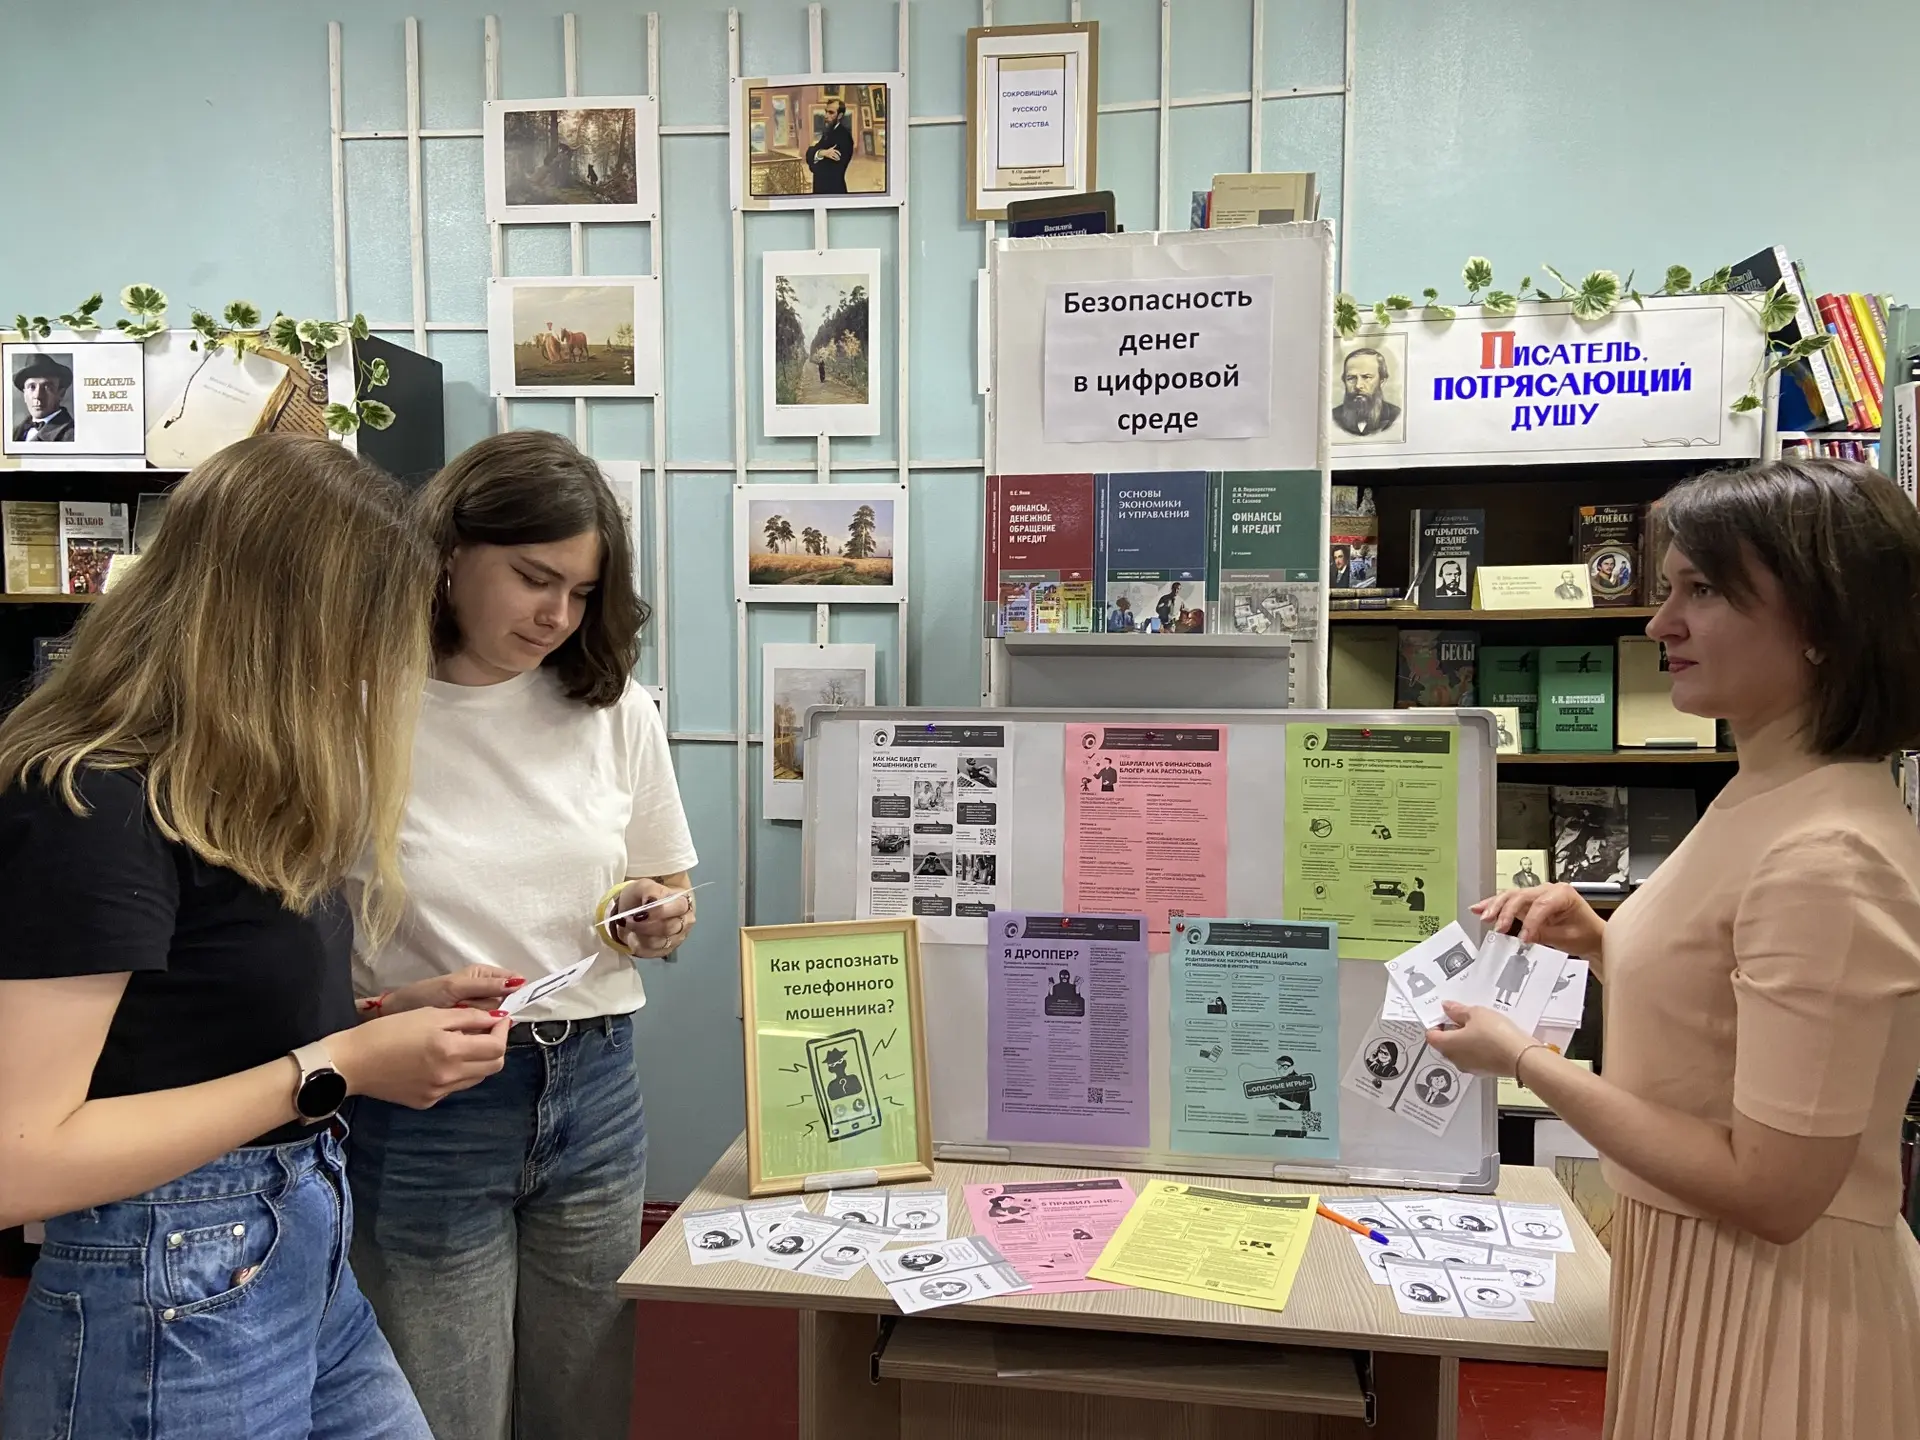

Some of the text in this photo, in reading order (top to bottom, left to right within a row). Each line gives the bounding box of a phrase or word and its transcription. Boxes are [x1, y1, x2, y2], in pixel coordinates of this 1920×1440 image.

[1002, 89, 1058, 98] СОКРОВИЩНИЦА
[1012, 105, 1048, 113] РУССКОГО
[1009, 121, 1050, 129] ИСКУССТВА
[1063, 290, 1253, 314] Безопасность
[1118, 332, 1200, 357] денег
[83, 377, 136, 387] ПИСАТЕЛЬ
[1073, 363, 1239, 396] в цифровой
[1433, 361, 1692, 401] ПОТРЯСАЮЩИЙ
[92, 390, 128, 399] НА ВСЕ
[86, 402, 135, 412] ВРЕМЕНА
[1117, 410, 1199, 435] среде
[1510, 403, 1600, 432] ДУШУ
[1905, 413, 1913, 492] ЛИТЕРАТУРА
[1118, 490, 1162, 499] ОСНОВЫ
[1009, 503, 1051, 513] ФИНАНСЫ,
[1118, 500, 1182, 509] ЭКОНОМИКИ
[1009, 513, 1053, 524] ДЕНЕЖНОЕ
[1118, 510, 1190, 519] И УПРАВЛЕНИЯ
[1231, 511, 1283, 522] ФИНАНСЫ
[1009, 524, 1056, 533] ОБРАЩЕНИЕ
[1231, 524, 1282, 535] И КРЕДИТ
[1009, 534, 1048, 544] И КРЕДИТ
[1435, 536, 1468, 545] БЕЗДНЕ
[1440, 643, 1476, 661] БЕСЫ
[1565, 693, 1606, 704] ДОСТОЕВСКИЙ
[1302, 757, 1344, 769] ТОП-5
[1004, 949, 1080, 960] Я ДРОППЕР?
[1191, 949, 1225, 957] ВАЖНЫХ
[1226, 950, 1288, 959] РЕКОМЕНДАЦИЙ
[770, 954, 899, 974] Как распознать
[784, 978, 894, 996] телефонного
[785, 999, 895, 1020] мошенника?
[1247, 1083, 1286, 1093] «ОПАСНЫЕ
